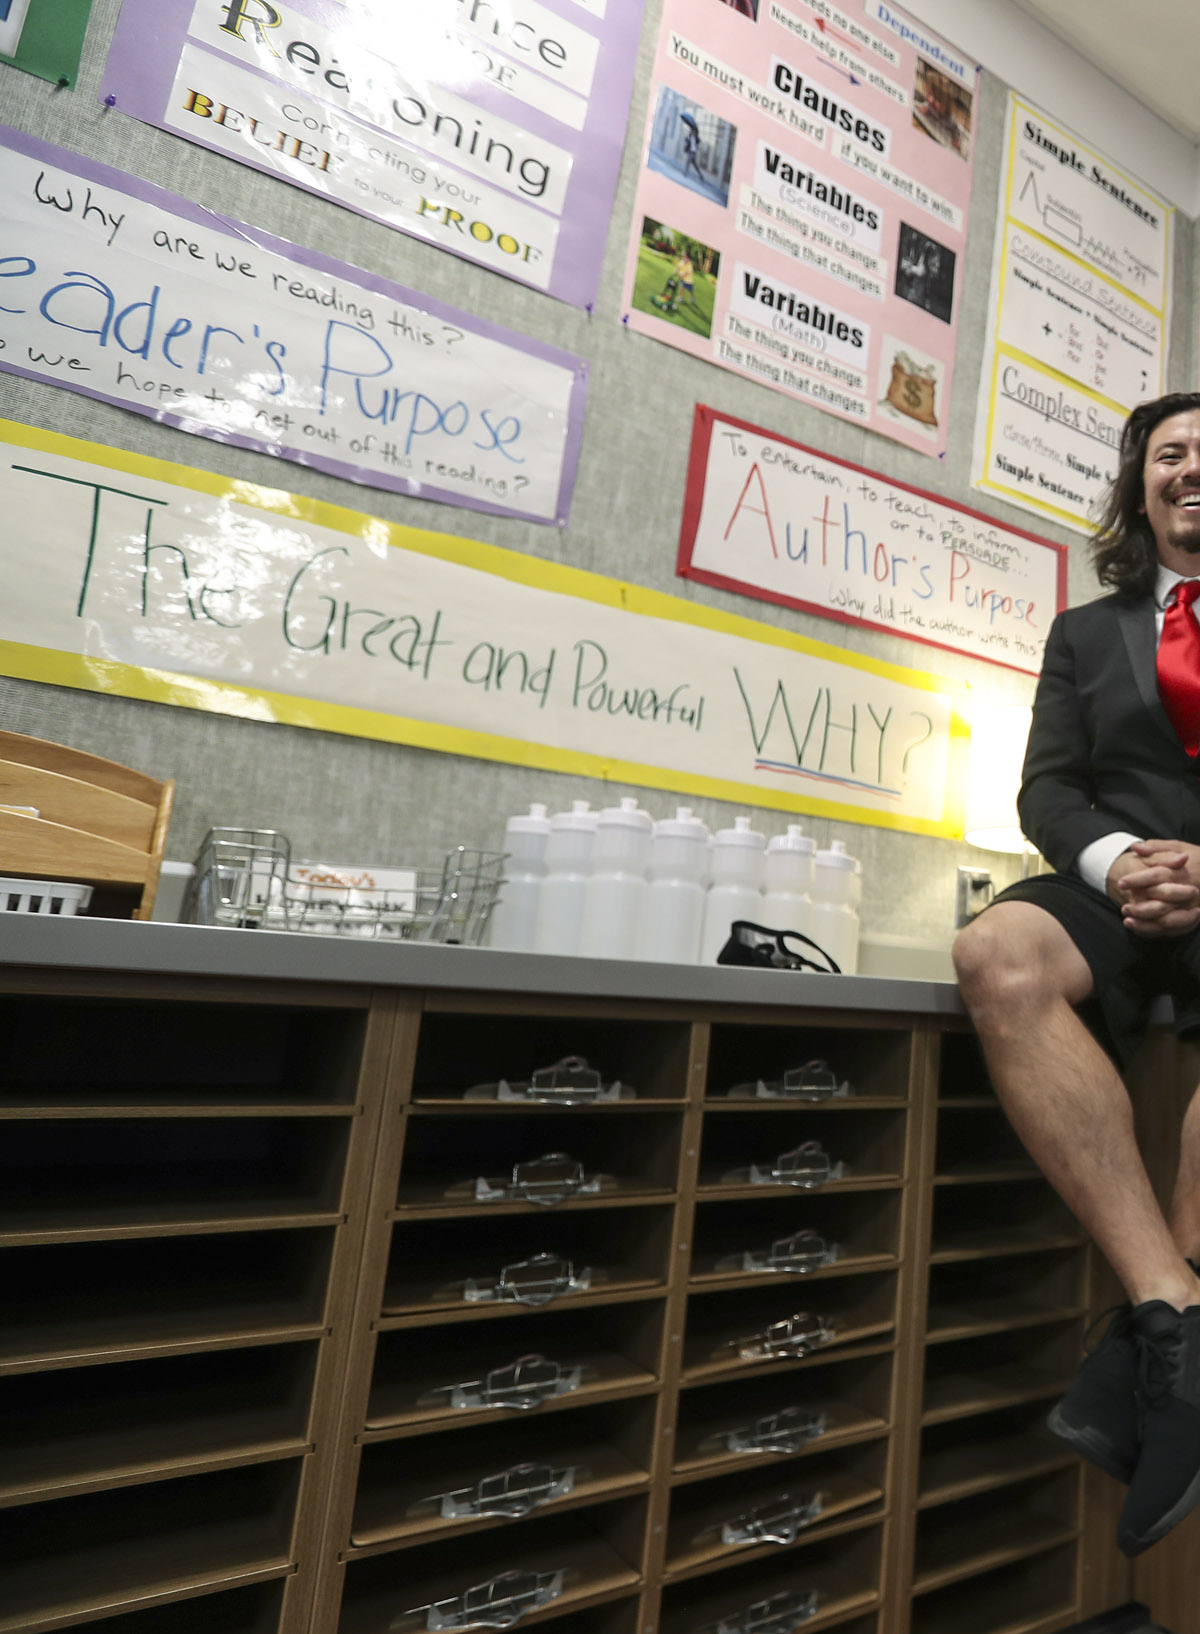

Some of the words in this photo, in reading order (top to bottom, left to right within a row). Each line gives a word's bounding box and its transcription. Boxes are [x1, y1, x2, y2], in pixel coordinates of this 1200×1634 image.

[876, 5, 966, 79] Dependent
[183, 88, 343, 173] BELIEF
[672, 36, 699, 67] You
[704, 58, 744, 94] must
[748, 84, 786, 121] work
[789, 106, 824, 142] hard
[774, 63, 886, 153] Clauses
[434, 175, 481, 206] your
[764, 148, 878, 231] Variables
[1024, 120, 1086, 171] Simple
[1092, 165, 1159, 227] Sentence
[35, 172, 125, 246] Why
[154, 228, 204, 260] are
[216, 251, 256, 278] we
[271, 272, 375, 331] reading
[387, 311, 464, 354] this?
[416, 195, 543, 263] PROOF
[743, 272, 863, 349] Variables
[0, 256, 288, 396] eader's
[318, 318, 526, 464] Purpose
[719, 341, 742, 365] The
[746, 351, 781, 382] thing
[784, 366, 809, 392] that
[812, 378, 867, 416] changes.
[728, 316, 751, 339] The
[755, 326, 789, 356] thing
[791, 345, 814, 372] you
[816, 352, 864, 389] change.
[28, 346, 91, 371] we
[117, 361, 188, 399] hope
[303, 424, 340, 443] out
[350, 435, 377, 454] of
[380, 441, 412, 469] this
[426, 458, 529, 498] reading?
[1002, 365, 1081, 429] Complex
[995, 453, 1034, 483] Simple
[1038, 470, 1084, 505] Sentence
[723, 461, 934, 600] Author's
[949, 549, 1039, 629] Purpose
[12, 464, 242, 628] The
[282, 546, 453, 679] Great
[463, 640, 555, 708] and
[573, 638, 705, 731] Powerful
[733, 665, 933, 786] WHY?
[828, 580, 865, 621] Why
[873, 590, 895, 621] did
[900, 605, 925, 628] the
[929, 615, 974, 641] author
[977, 630, 1008, 649] write
